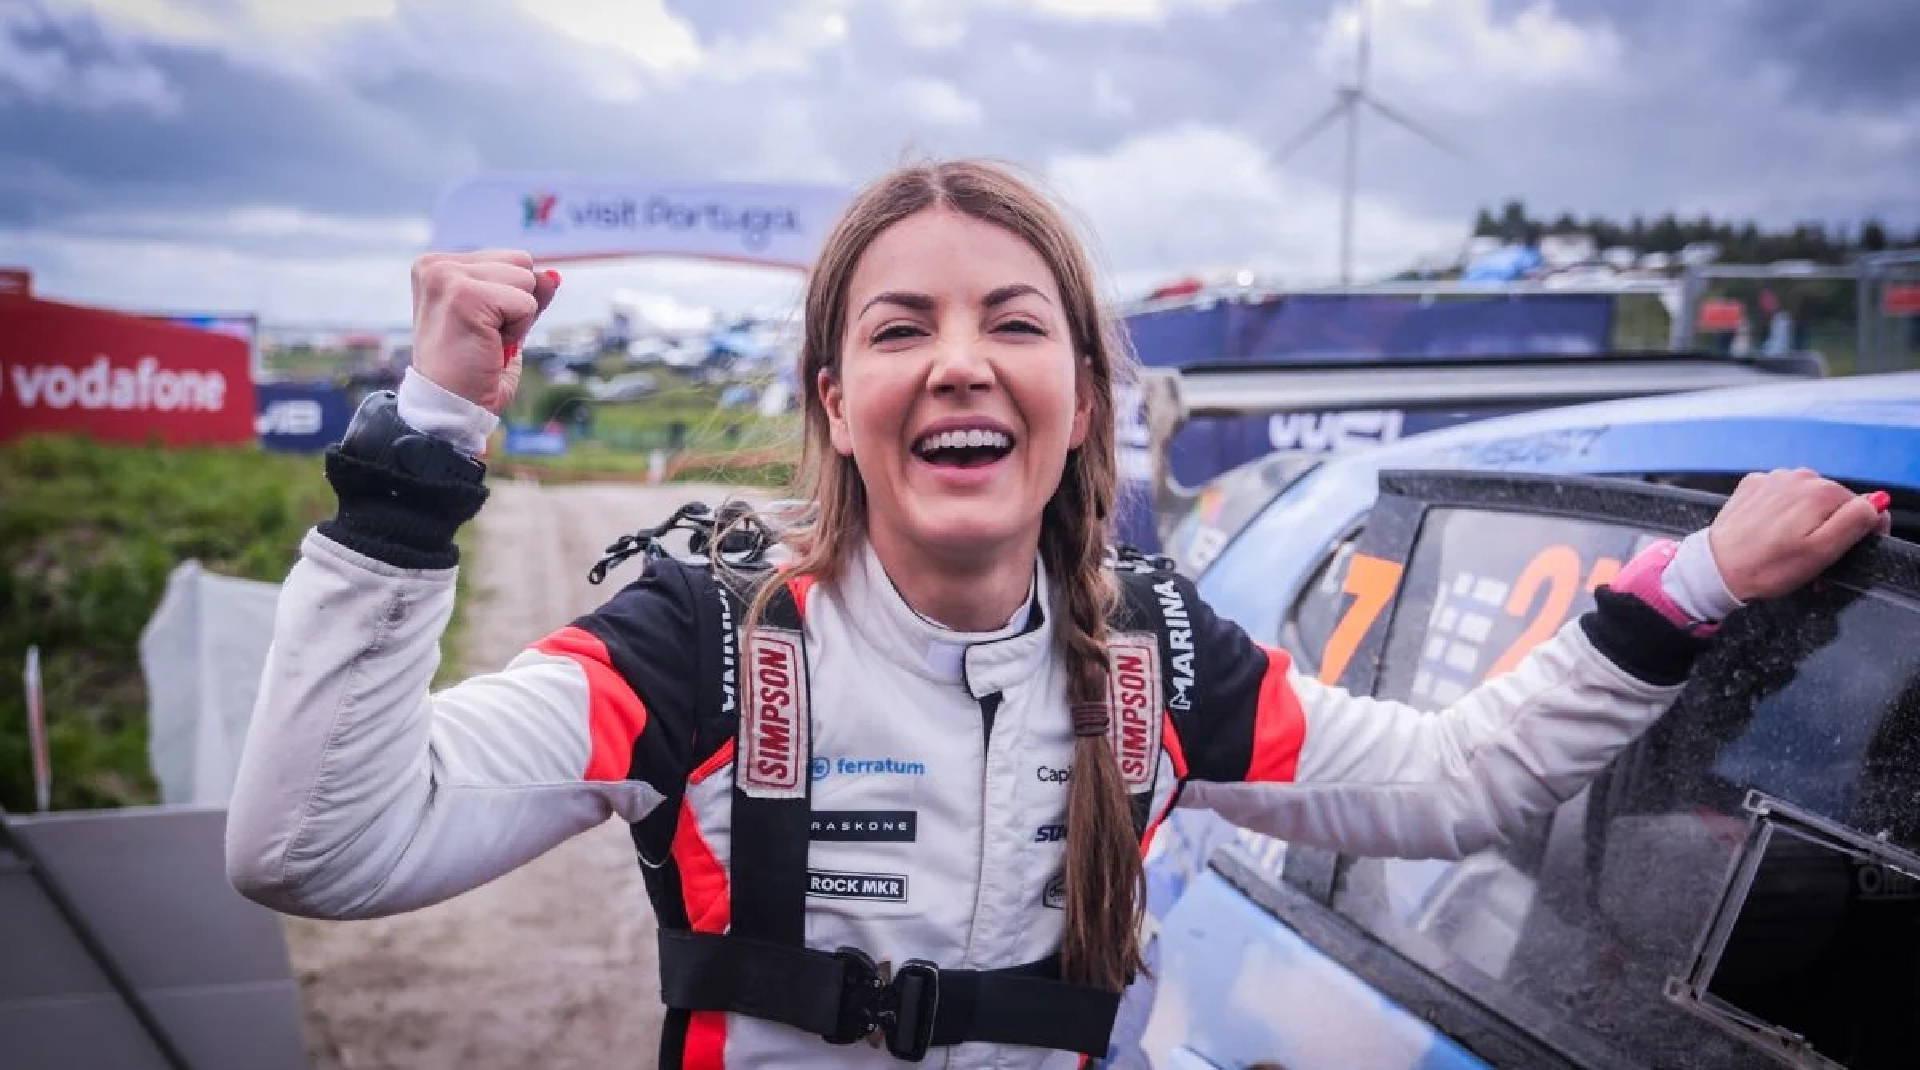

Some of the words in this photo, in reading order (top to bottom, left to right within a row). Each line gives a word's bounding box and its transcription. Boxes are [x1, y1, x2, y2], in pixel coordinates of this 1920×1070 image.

[12, 355, 226, 411] vodafone
[1152, 579, 1195, 711] MARINA
[757, 648, 790, 780] SIMPSON
[1116, 655, 1148, 777] SIMPSON
[837, 757, 926, 776] ferratum
[810, 877, 859, 894] ROCK
[861, 879, 900, 895] MKR
